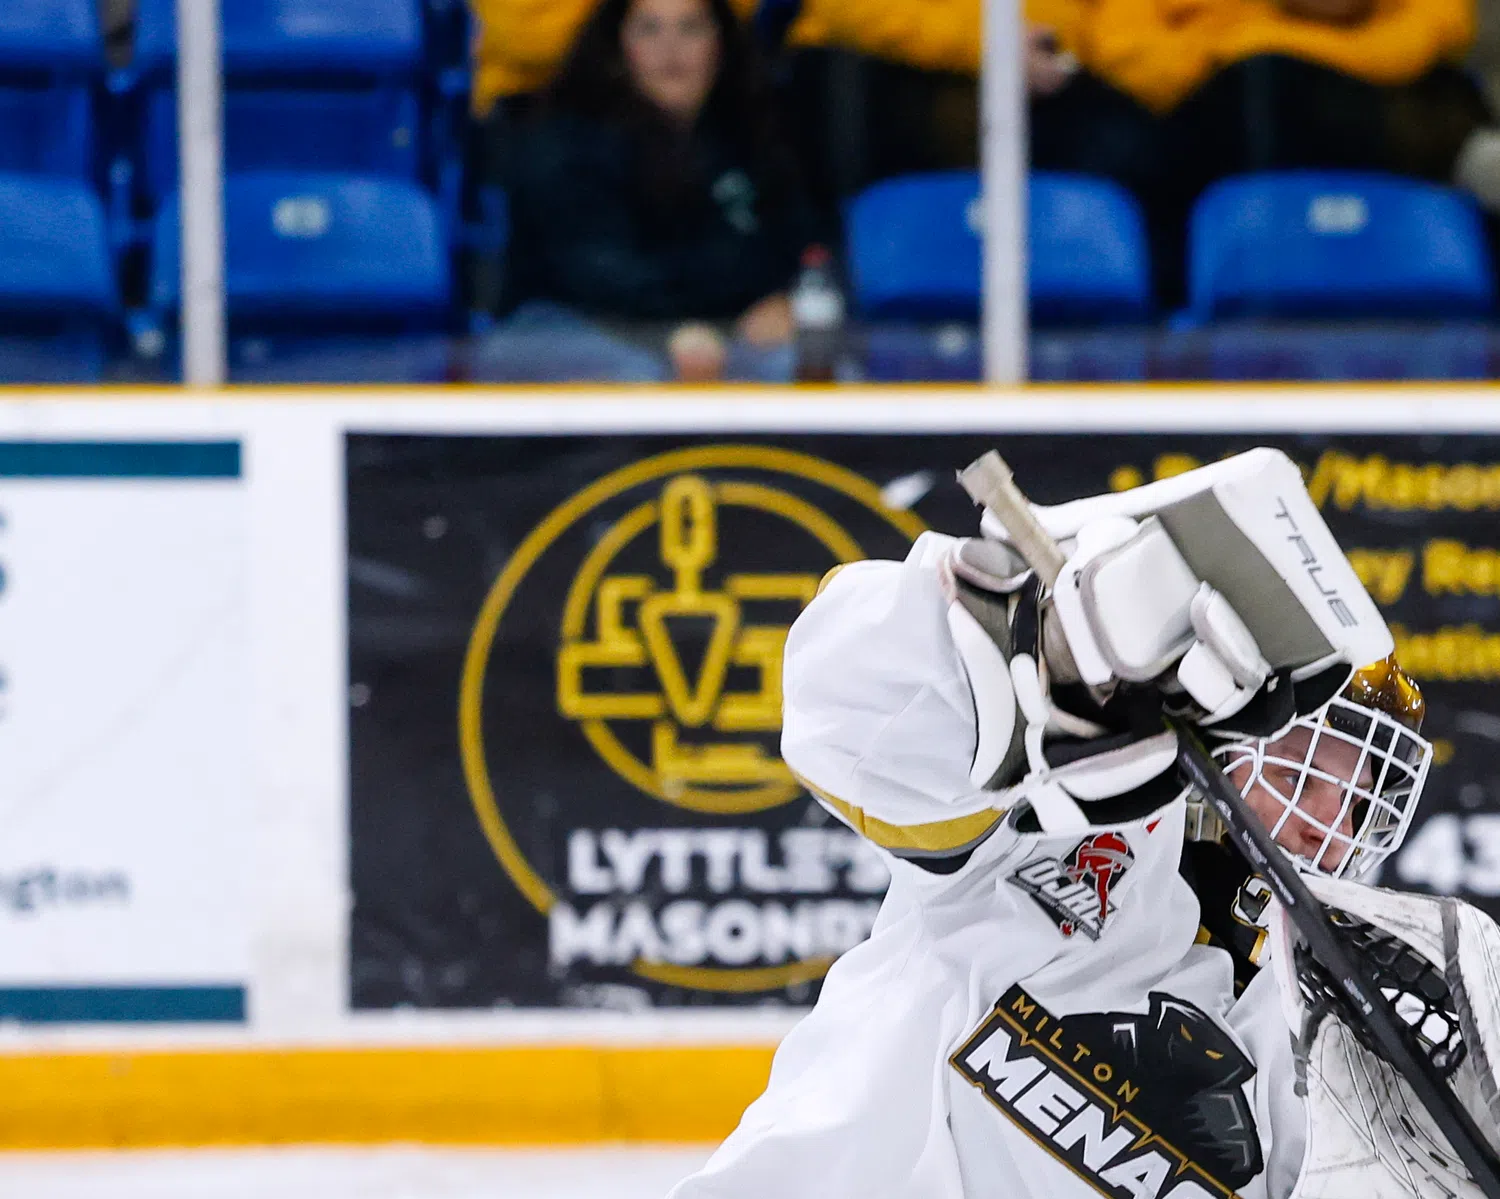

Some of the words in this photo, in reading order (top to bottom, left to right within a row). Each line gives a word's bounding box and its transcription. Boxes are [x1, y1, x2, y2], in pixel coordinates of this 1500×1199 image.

[1274, 496, 1358, 628] TRUE
[567, 827, 892, 895] LYTTLE'S
[549, 898, 882, 967] MASONR
[1011, 994, 1140, 1102] MILTON
